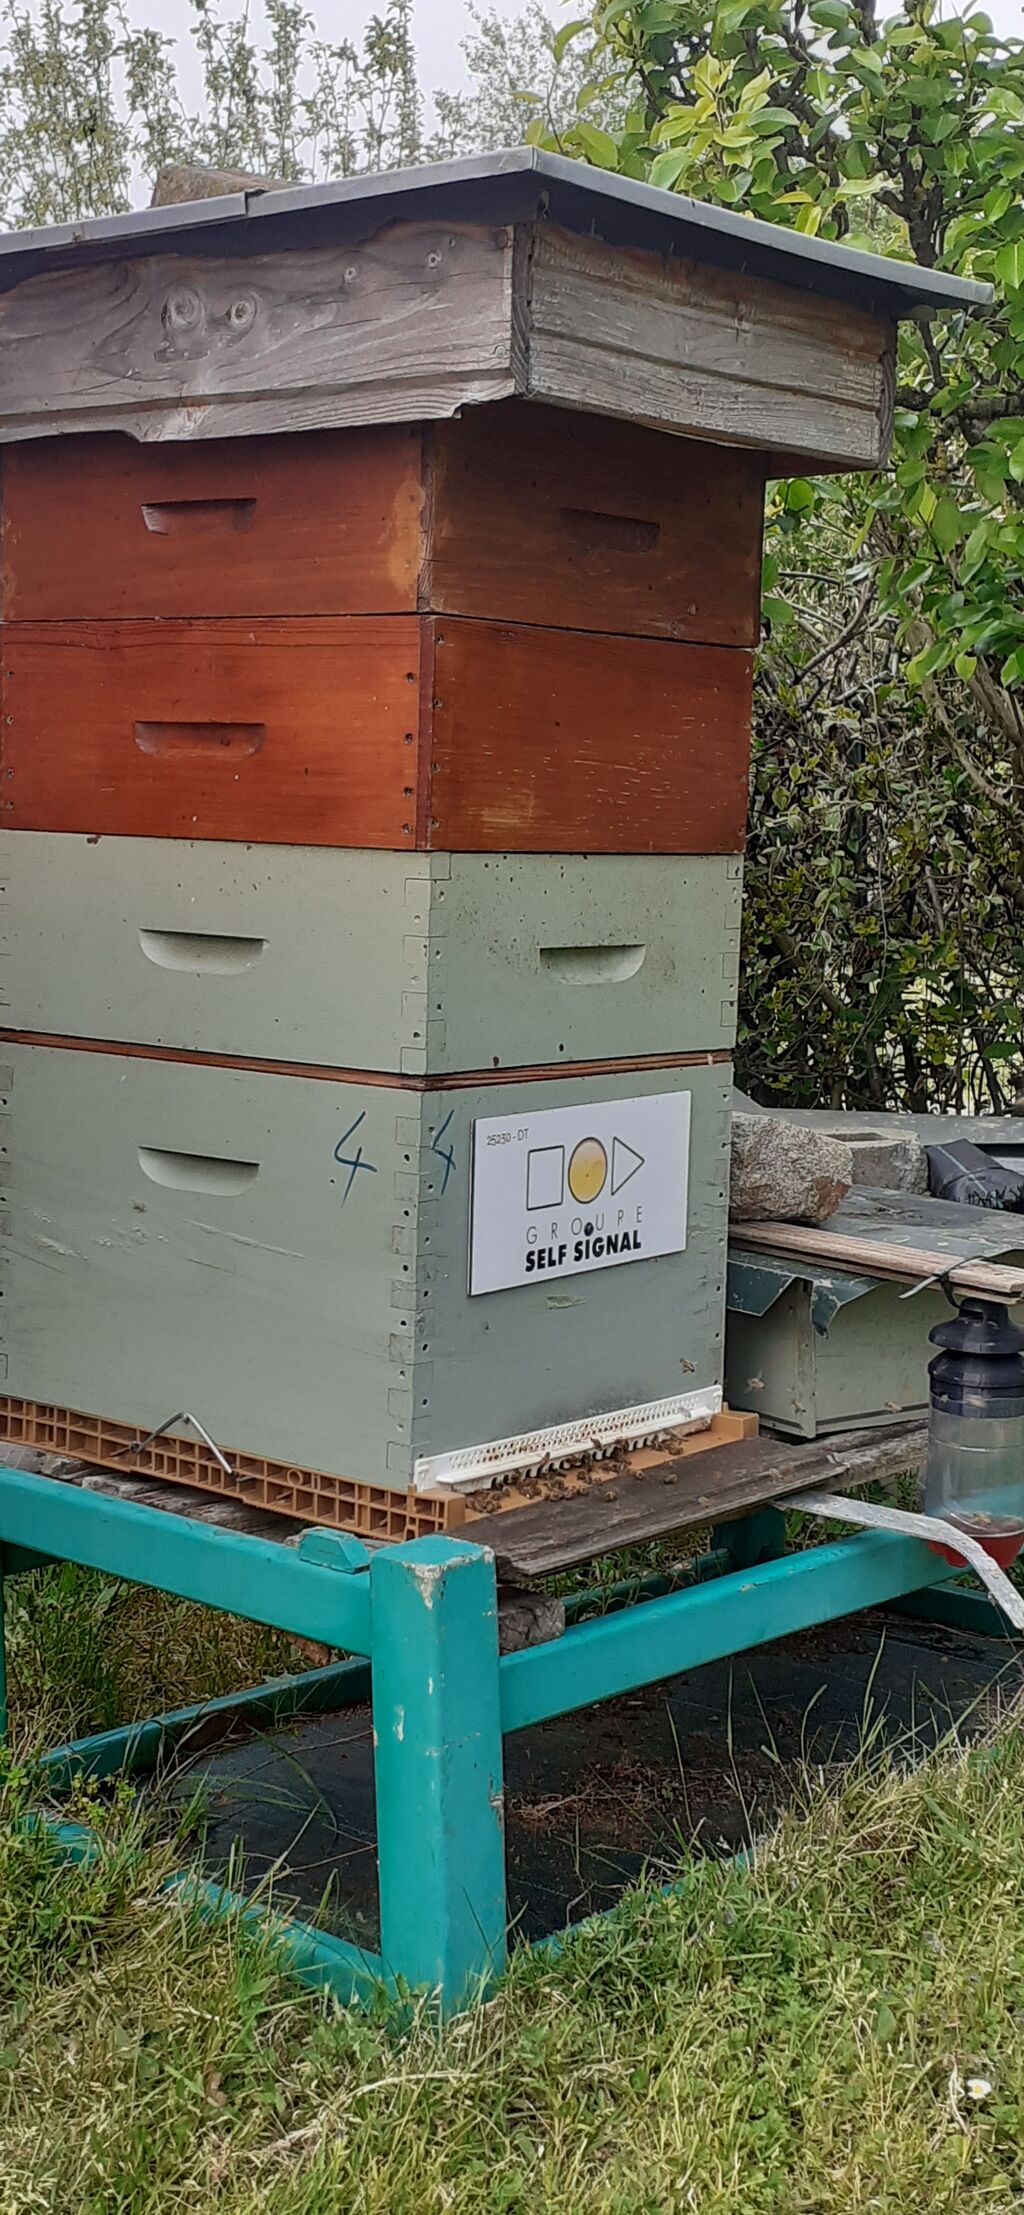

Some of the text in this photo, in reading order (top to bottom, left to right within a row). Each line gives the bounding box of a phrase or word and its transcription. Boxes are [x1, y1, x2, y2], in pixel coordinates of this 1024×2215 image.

[334, 1110, 378, 1209] 4
[431, 1109, 457, 1196] 4
[525, 1229, 642, 1273] SELF SIGNAL
[526, 1205, 643, 1245] GROUPE
